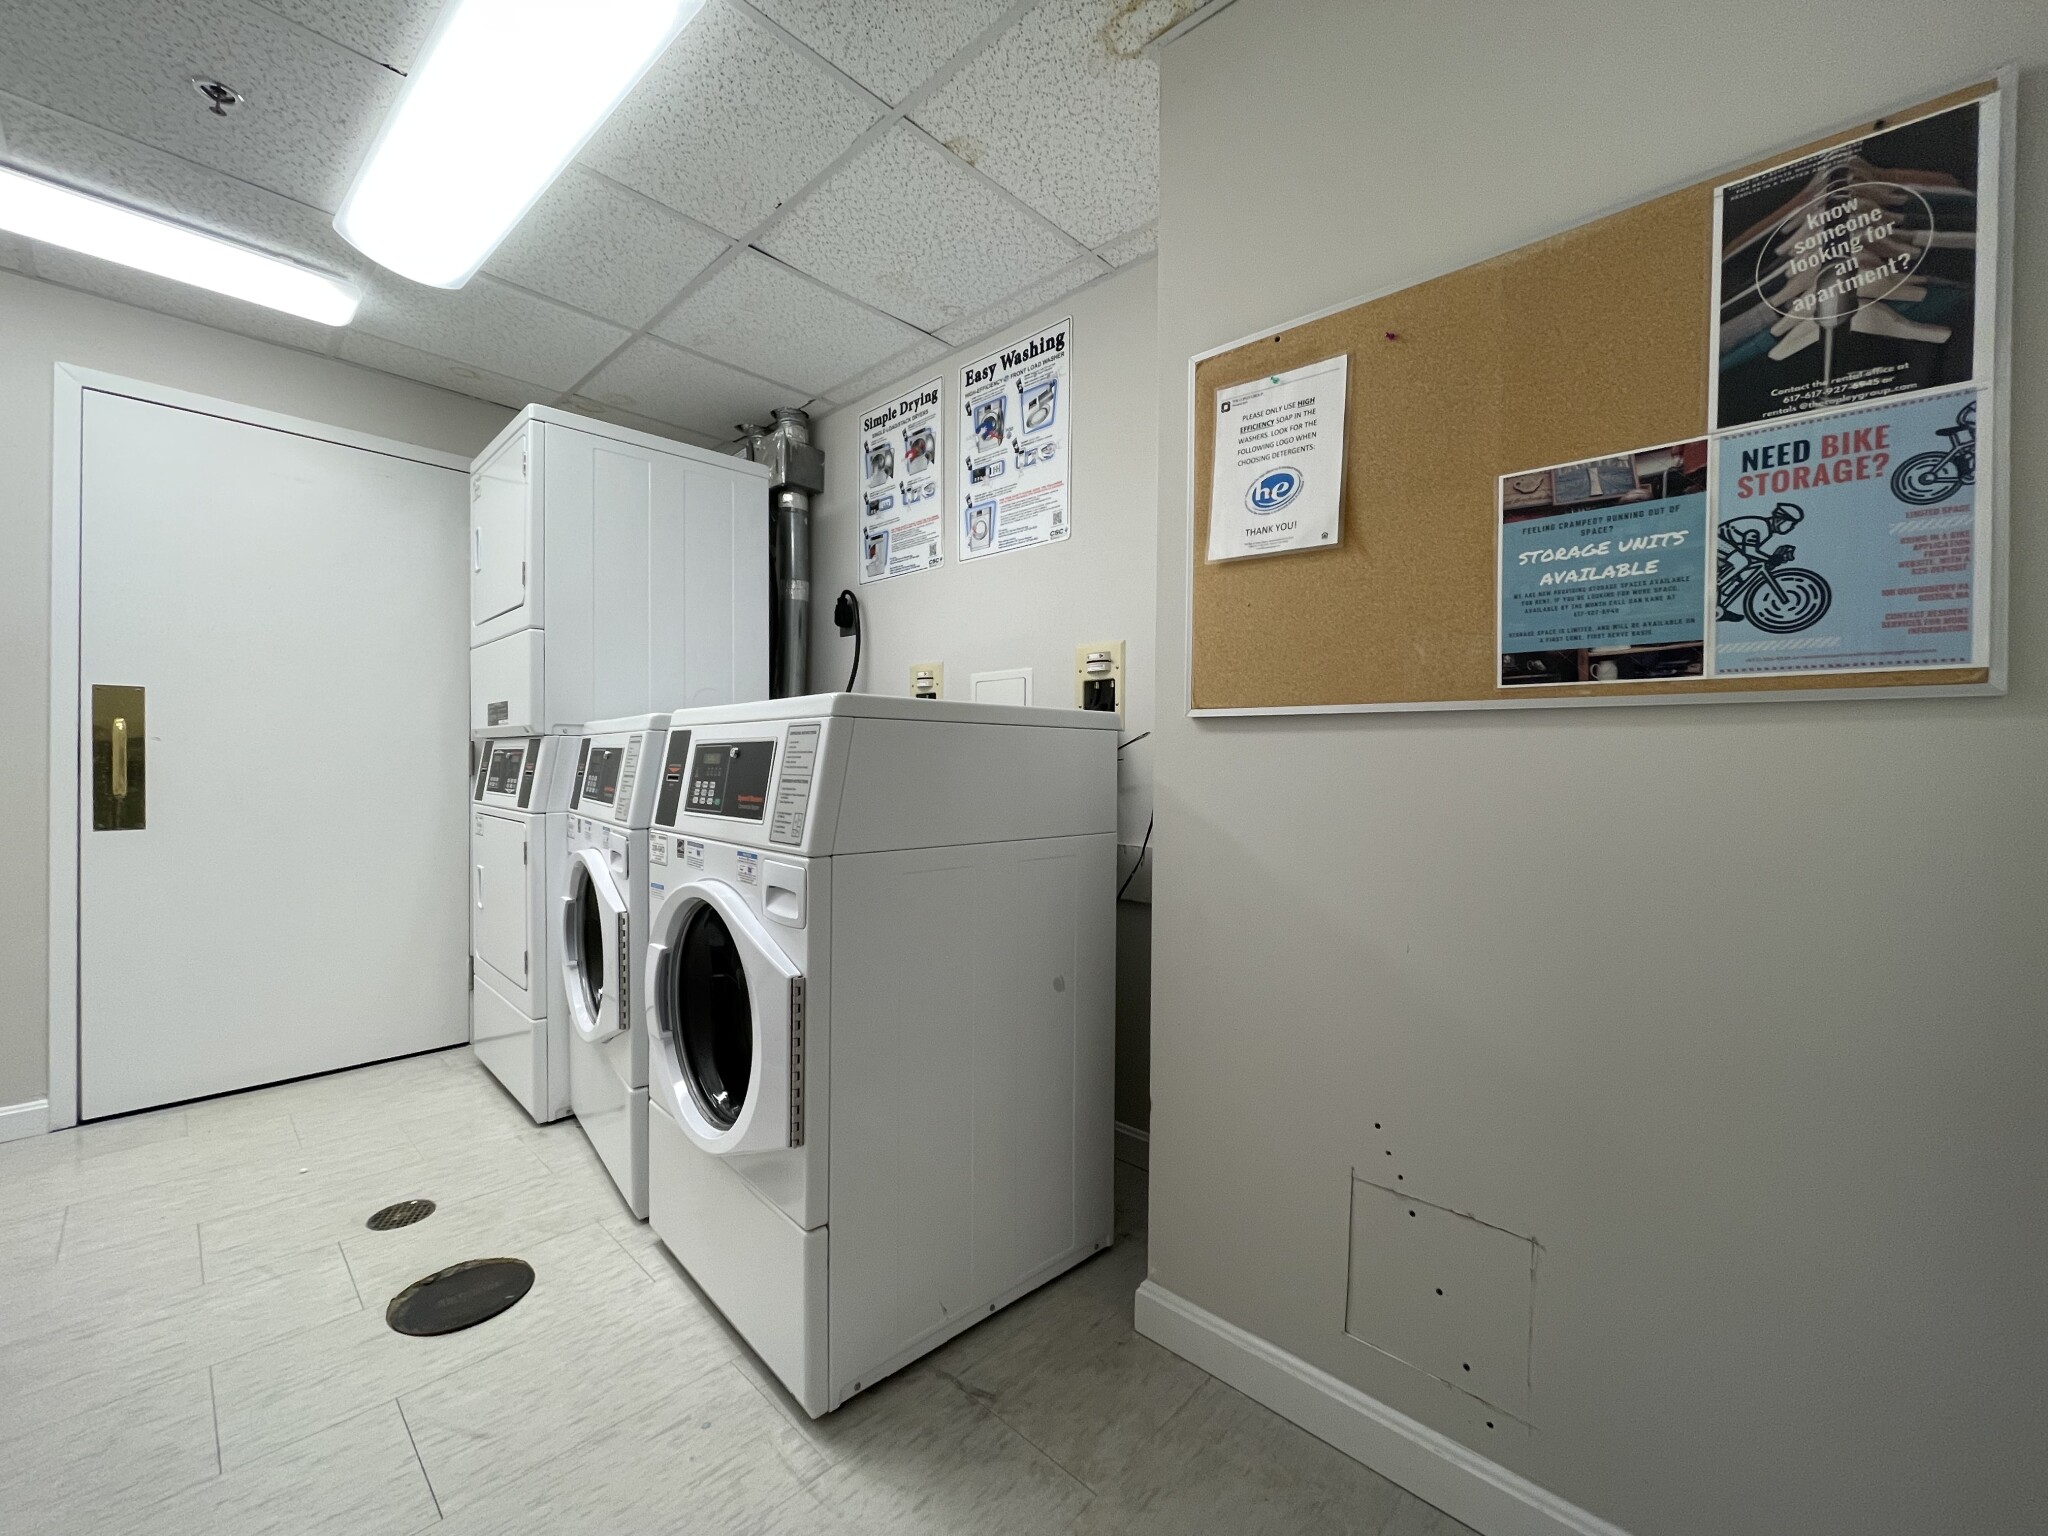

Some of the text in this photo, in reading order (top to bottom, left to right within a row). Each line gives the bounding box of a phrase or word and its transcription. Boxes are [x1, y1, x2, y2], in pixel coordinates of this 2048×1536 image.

[1807, 198, 1858, 230] know
[1794, 208, 1882, 254] someone
[1790, 220, 1895, 274] looking for
[1834, 257, 1859, 276] an
[1792, 253, 1910, 312] apartment?
[965, 363, 997, 387] Easy
[1000, 331, 1065, 370] Washing
[1010, 367, 1027, 379] FRONT
[1028, 362, 1041, 372] LOAD
[1042, 352, 1065, 365] WASHER
[1770, 362, 1910, 396] Contact the rental office at
[1882, 376, 1895, 384] or
[864, 407, 897, 432] Simple
[900, 389, 938, 416] Drying
[1240, 419, 1274, 435] EFFICIENCY
[1276, 414, 1293, 424] SOAP
[1304, 408, 1316, 416] THE
[1242, 397, 1315, 421] PLEASE ONLY USE HIGH
[1762, 406, 1797, 418] rentals
[1237, 432, 1317, 456] FOLLOWING LOGO WHEN
[1238, 419, 1317, 444] WASHERS. LOOK FOR THE
[1237, 444, 1315, 466] CHOOSING DETERGENTS:
[1742, 425, 1890, 473] NEED BIKE
[1737, 452, 1890, 500] STORAGE?
[1255, 480, 1289, 501] he
[1246, 521, 1297, 536] THANK YOU!
[1522, 505, 1680, 535] FEELING CRAMPED? RUNNING OUT OF
[1580, 526, 1613, 536] SPACE?
[1518, 530, 1689, 566] STORAGE UNITS
[1540, 560, 1659, 586] AVAILABLE
[1620, 580, 1647, 588] SPACES
[1650, 576, 1690, 585] AVAILABLE
[1525, 606, 1558, 614] AVAILABLE
[1642, 619, 1682, 627] AVAILABLE
